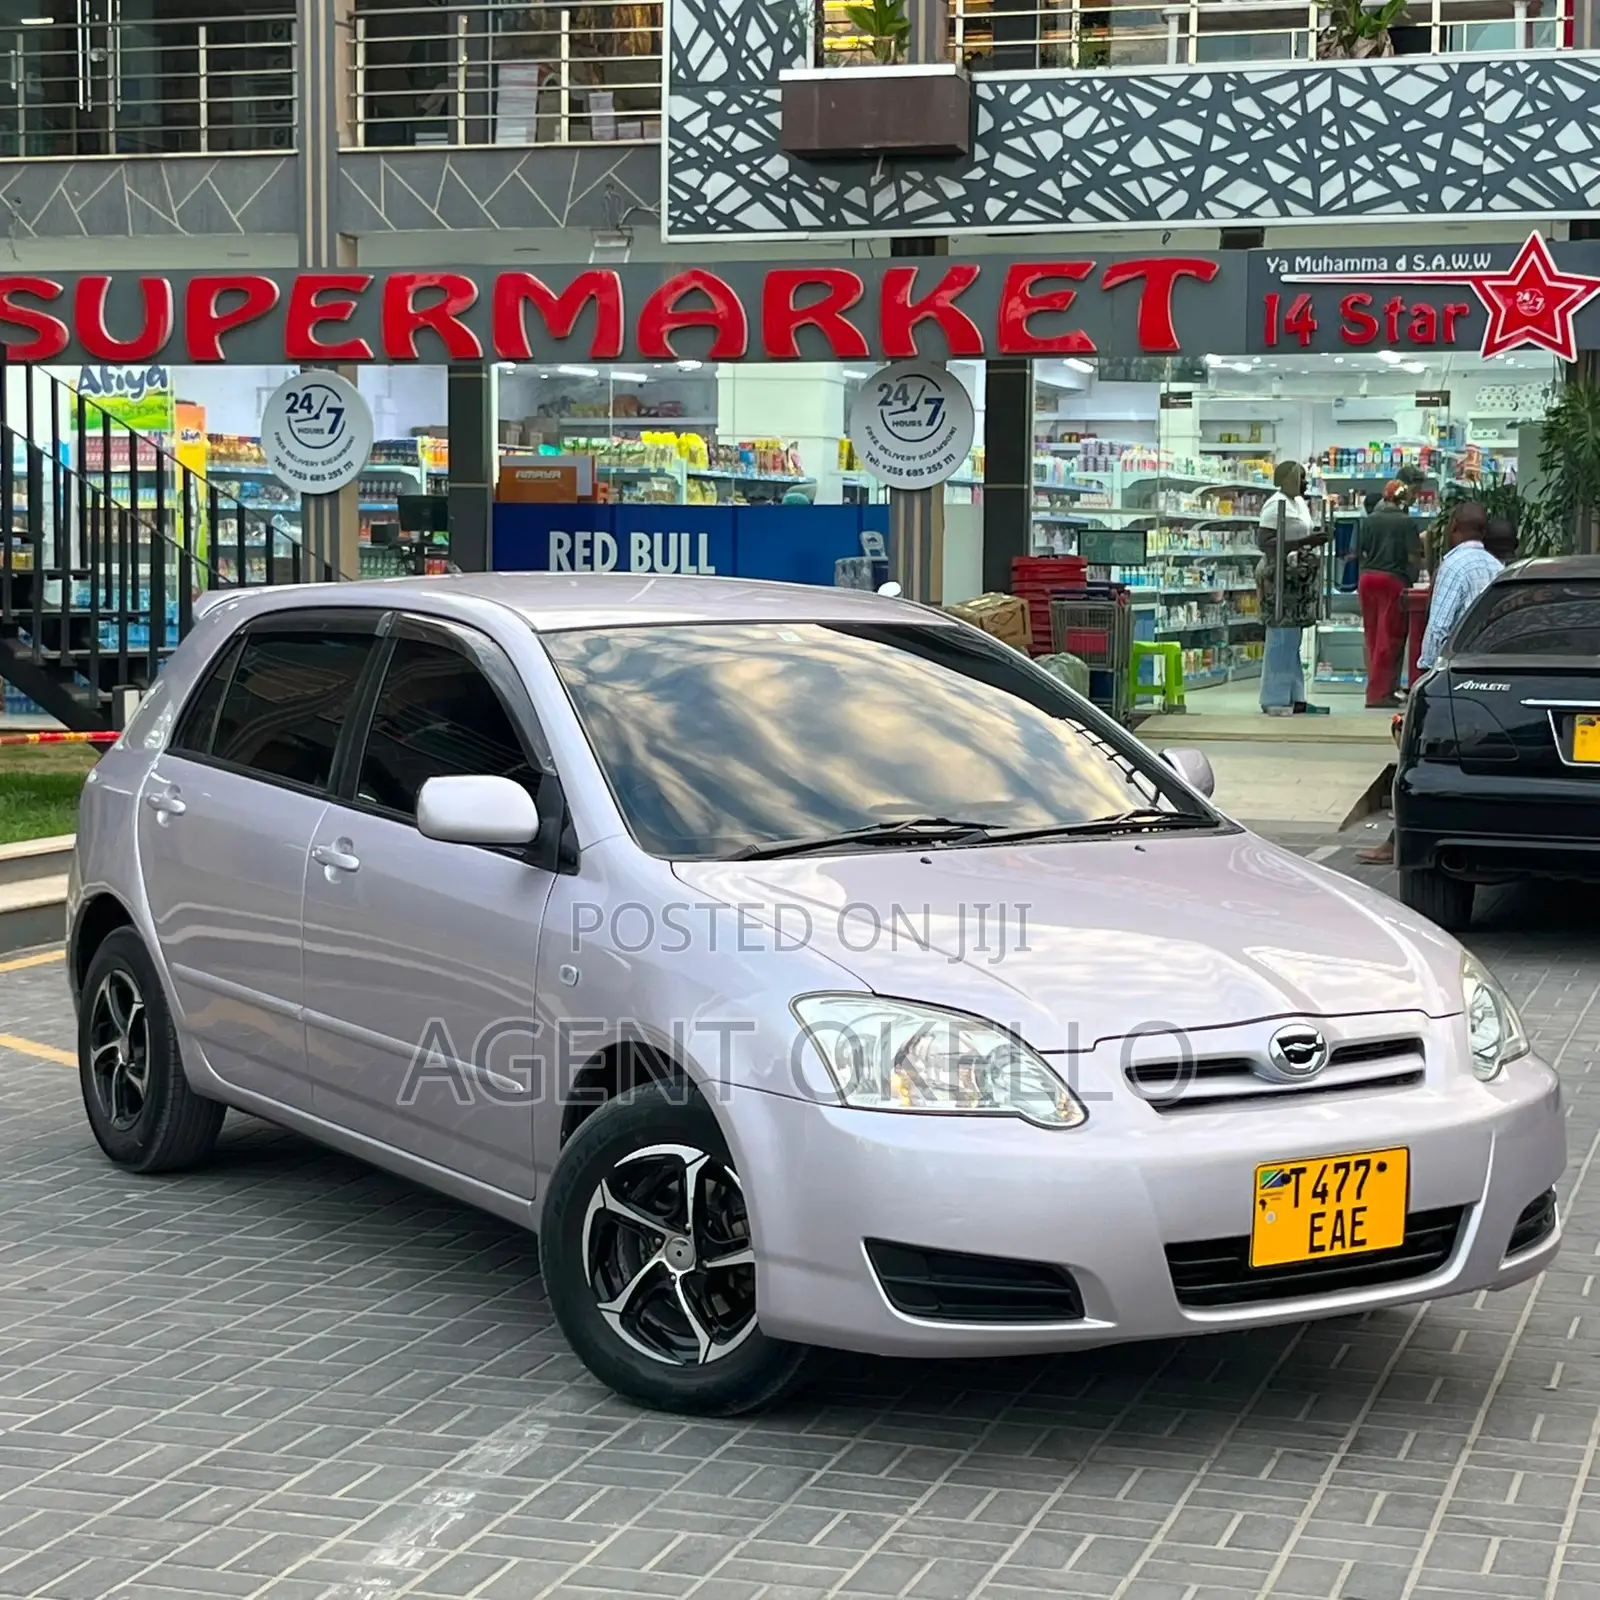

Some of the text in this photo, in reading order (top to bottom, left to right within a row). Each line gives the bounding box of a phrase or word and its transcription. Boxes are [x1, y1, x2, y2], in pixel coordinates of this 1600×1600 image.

[1266, 256, 1288, 274] Ya
[1412, 252, 1492, 271] S.A.W.W
[0, 258, 1219, 362] SUPERMARKET
[1263, 291, 1470, 347] 14 Star
[77, 364, 168, 399] Afiya
[298, 427, 325, 435] HOURS
[865, 425, 880, 446] FREE
[878, 444, 917, 461] DELIVERY
[926, 461, 943, 474] 255
[549, 531, 716, 575] RED BULL
[1453, 679, 1512, 692] ATHLETE
[1290, 1158, 1371, 1208] T 477
[1308, 1206, 1368, 1254] EAE
